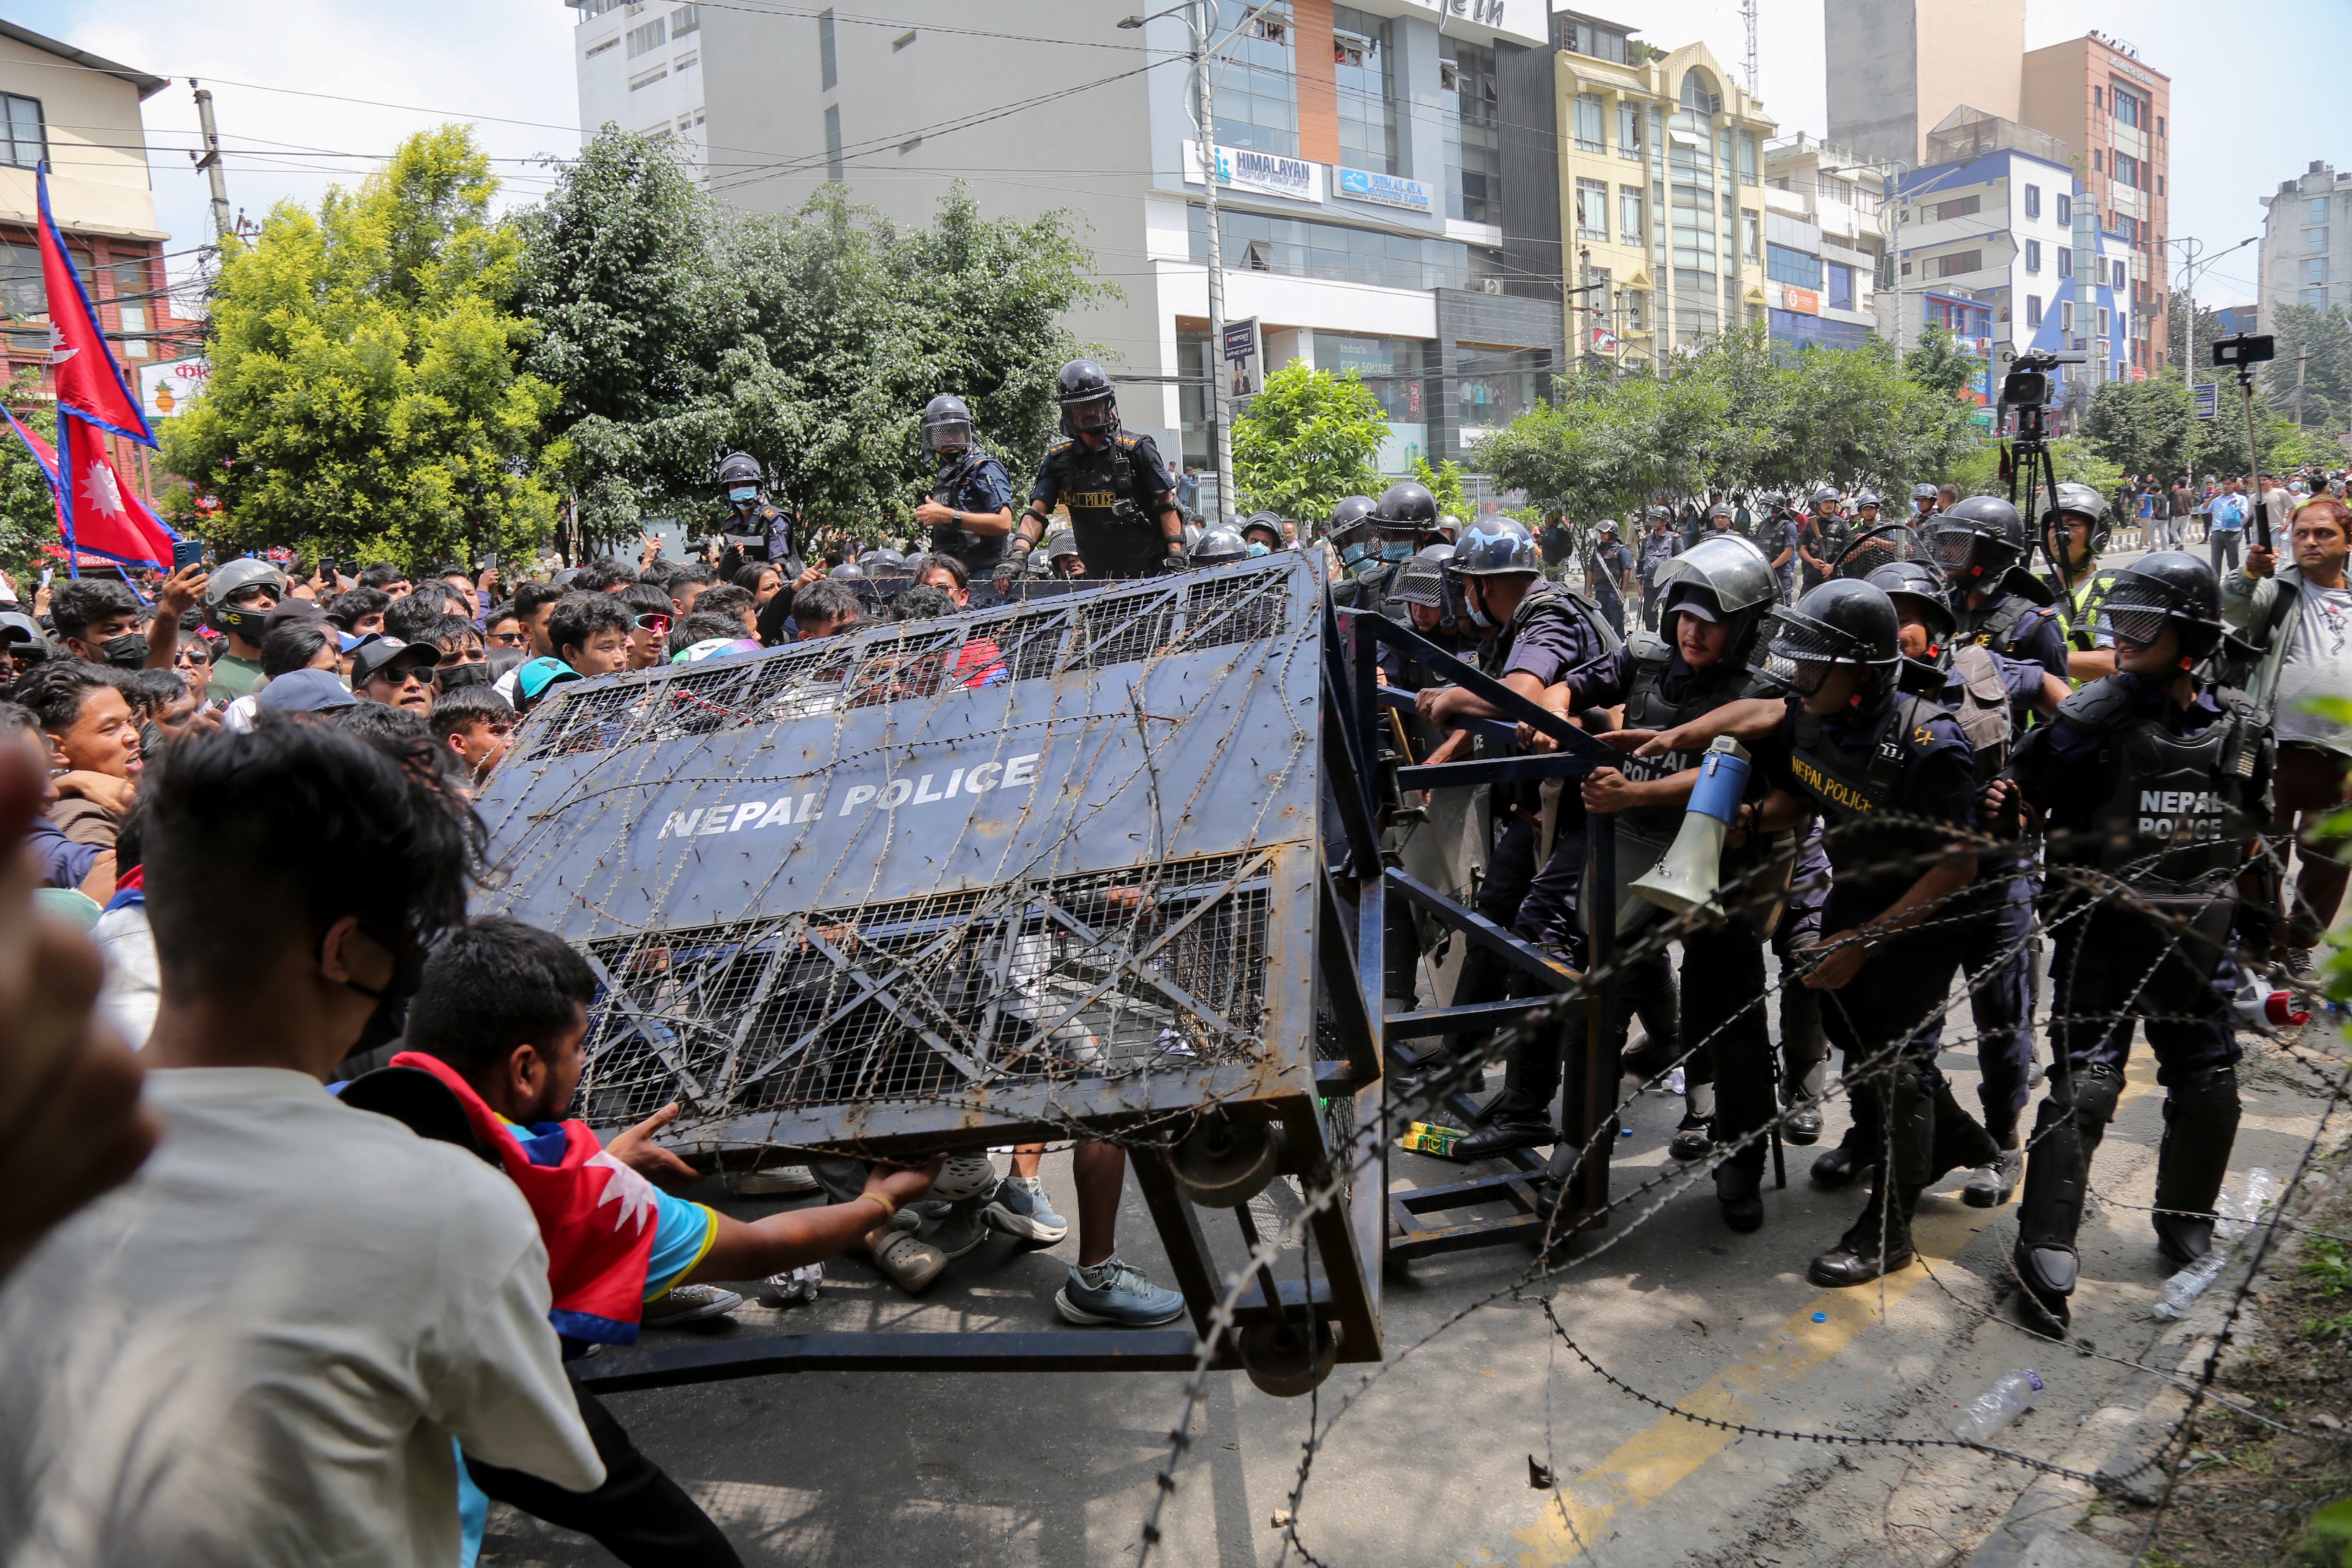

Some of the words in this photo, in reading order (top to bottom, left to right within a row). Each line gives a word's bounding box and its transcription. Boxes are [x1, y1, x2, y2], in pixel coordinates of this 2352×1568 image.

[1237, 151, 1310, 180] HIMALAYAN
[1237, 168, 1268, 181] INVESTMENT
[1270, 173, 1289, 185] BANKER
[1290, 177, 1309, 189] LIMITED
[1340, 343, 1367, 355] Indra's
[1341, 360, 1359, 372] CITY
[1362, 362, 1394, 375] SQUARE
[656, 793, 824, 840] NEPAL
[838, 753, 1041, 817] POLICE
[1792, 755, 1823, 791] NEPAL
[1823, 778, 1872, 815] POLICE
[2140, 790, 2223, 813] NEPAL
